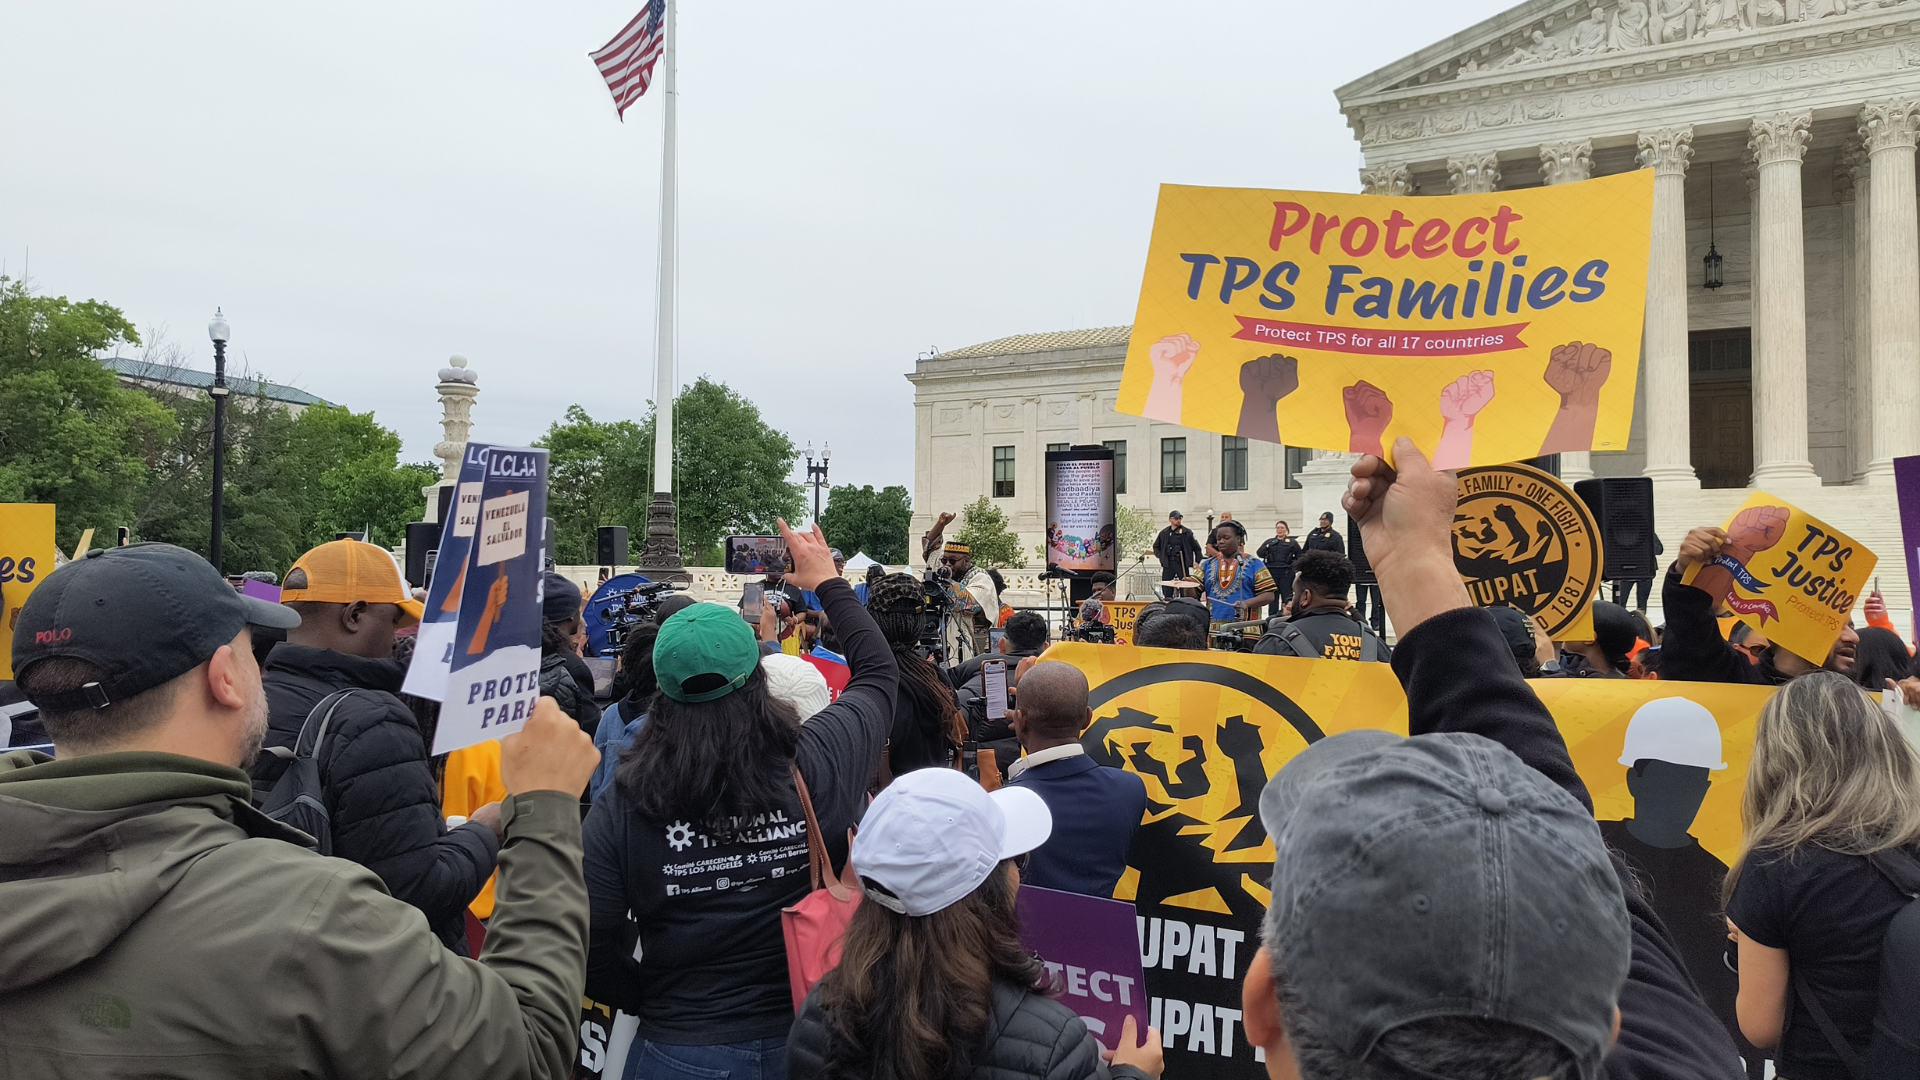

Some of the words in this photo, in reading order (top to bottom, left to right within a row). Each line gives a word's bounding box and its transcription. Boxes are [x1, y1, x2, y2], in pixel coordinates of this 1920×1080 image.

[1578, 86, 1648, 111] EQUAL
[1654, 74, 1737, 101] JUSTICE
[1748, 62, 1825, 87] UNDER
[1833, 52, 1880, 74] LAW
[1269, 201, 1523, 259] Protect
[1179, 253, 1300, 311] TPS
[1325, 255, 1609, 320] Families
[1255, 324, 1311, 342] Protect
[1316, 330, 1347, 346] TPS
[1351, 333, 1374, 348] for
[1377, 336, 1397, 349] all
[1401, 336, 1420, 350] 17
[1425, 333, 1504, 350] countries
[490, 454, 537, 477] LCLAA
[485, 502, 526, 520] VENEZUELA
[1464, 475, 1514, 494] FAMILY
[1525, 482, 1555, 507] ONE
[1548, 500, 1583, 536] FIGHT
[486, 528, 523, 545] SALVADOR
[503, 521, 511, 532] EL
[1797, 523, 1853, 573] TPS
[1715, 555, 1738, 570] Protect
[1737, 567, 1752, 585] TPS
[1771, 550, 1854, 614] Justice
[1551, 576, 1584, 616] 1887
[1114, 607, 1136, 618] TPS
[1785, 595, 1823, 623] Protect
[1824, 616, 1840, 631] TPS
[35, 628, 72, 644] POLO
[467, 669, 541, 705] PROTE
[696, 856, 727, 866] CARECEN
[788, 848, 809, 858] Berna
[689, 866, 705, 875] LOS
[706, 860, 743, 872] ANGELES
